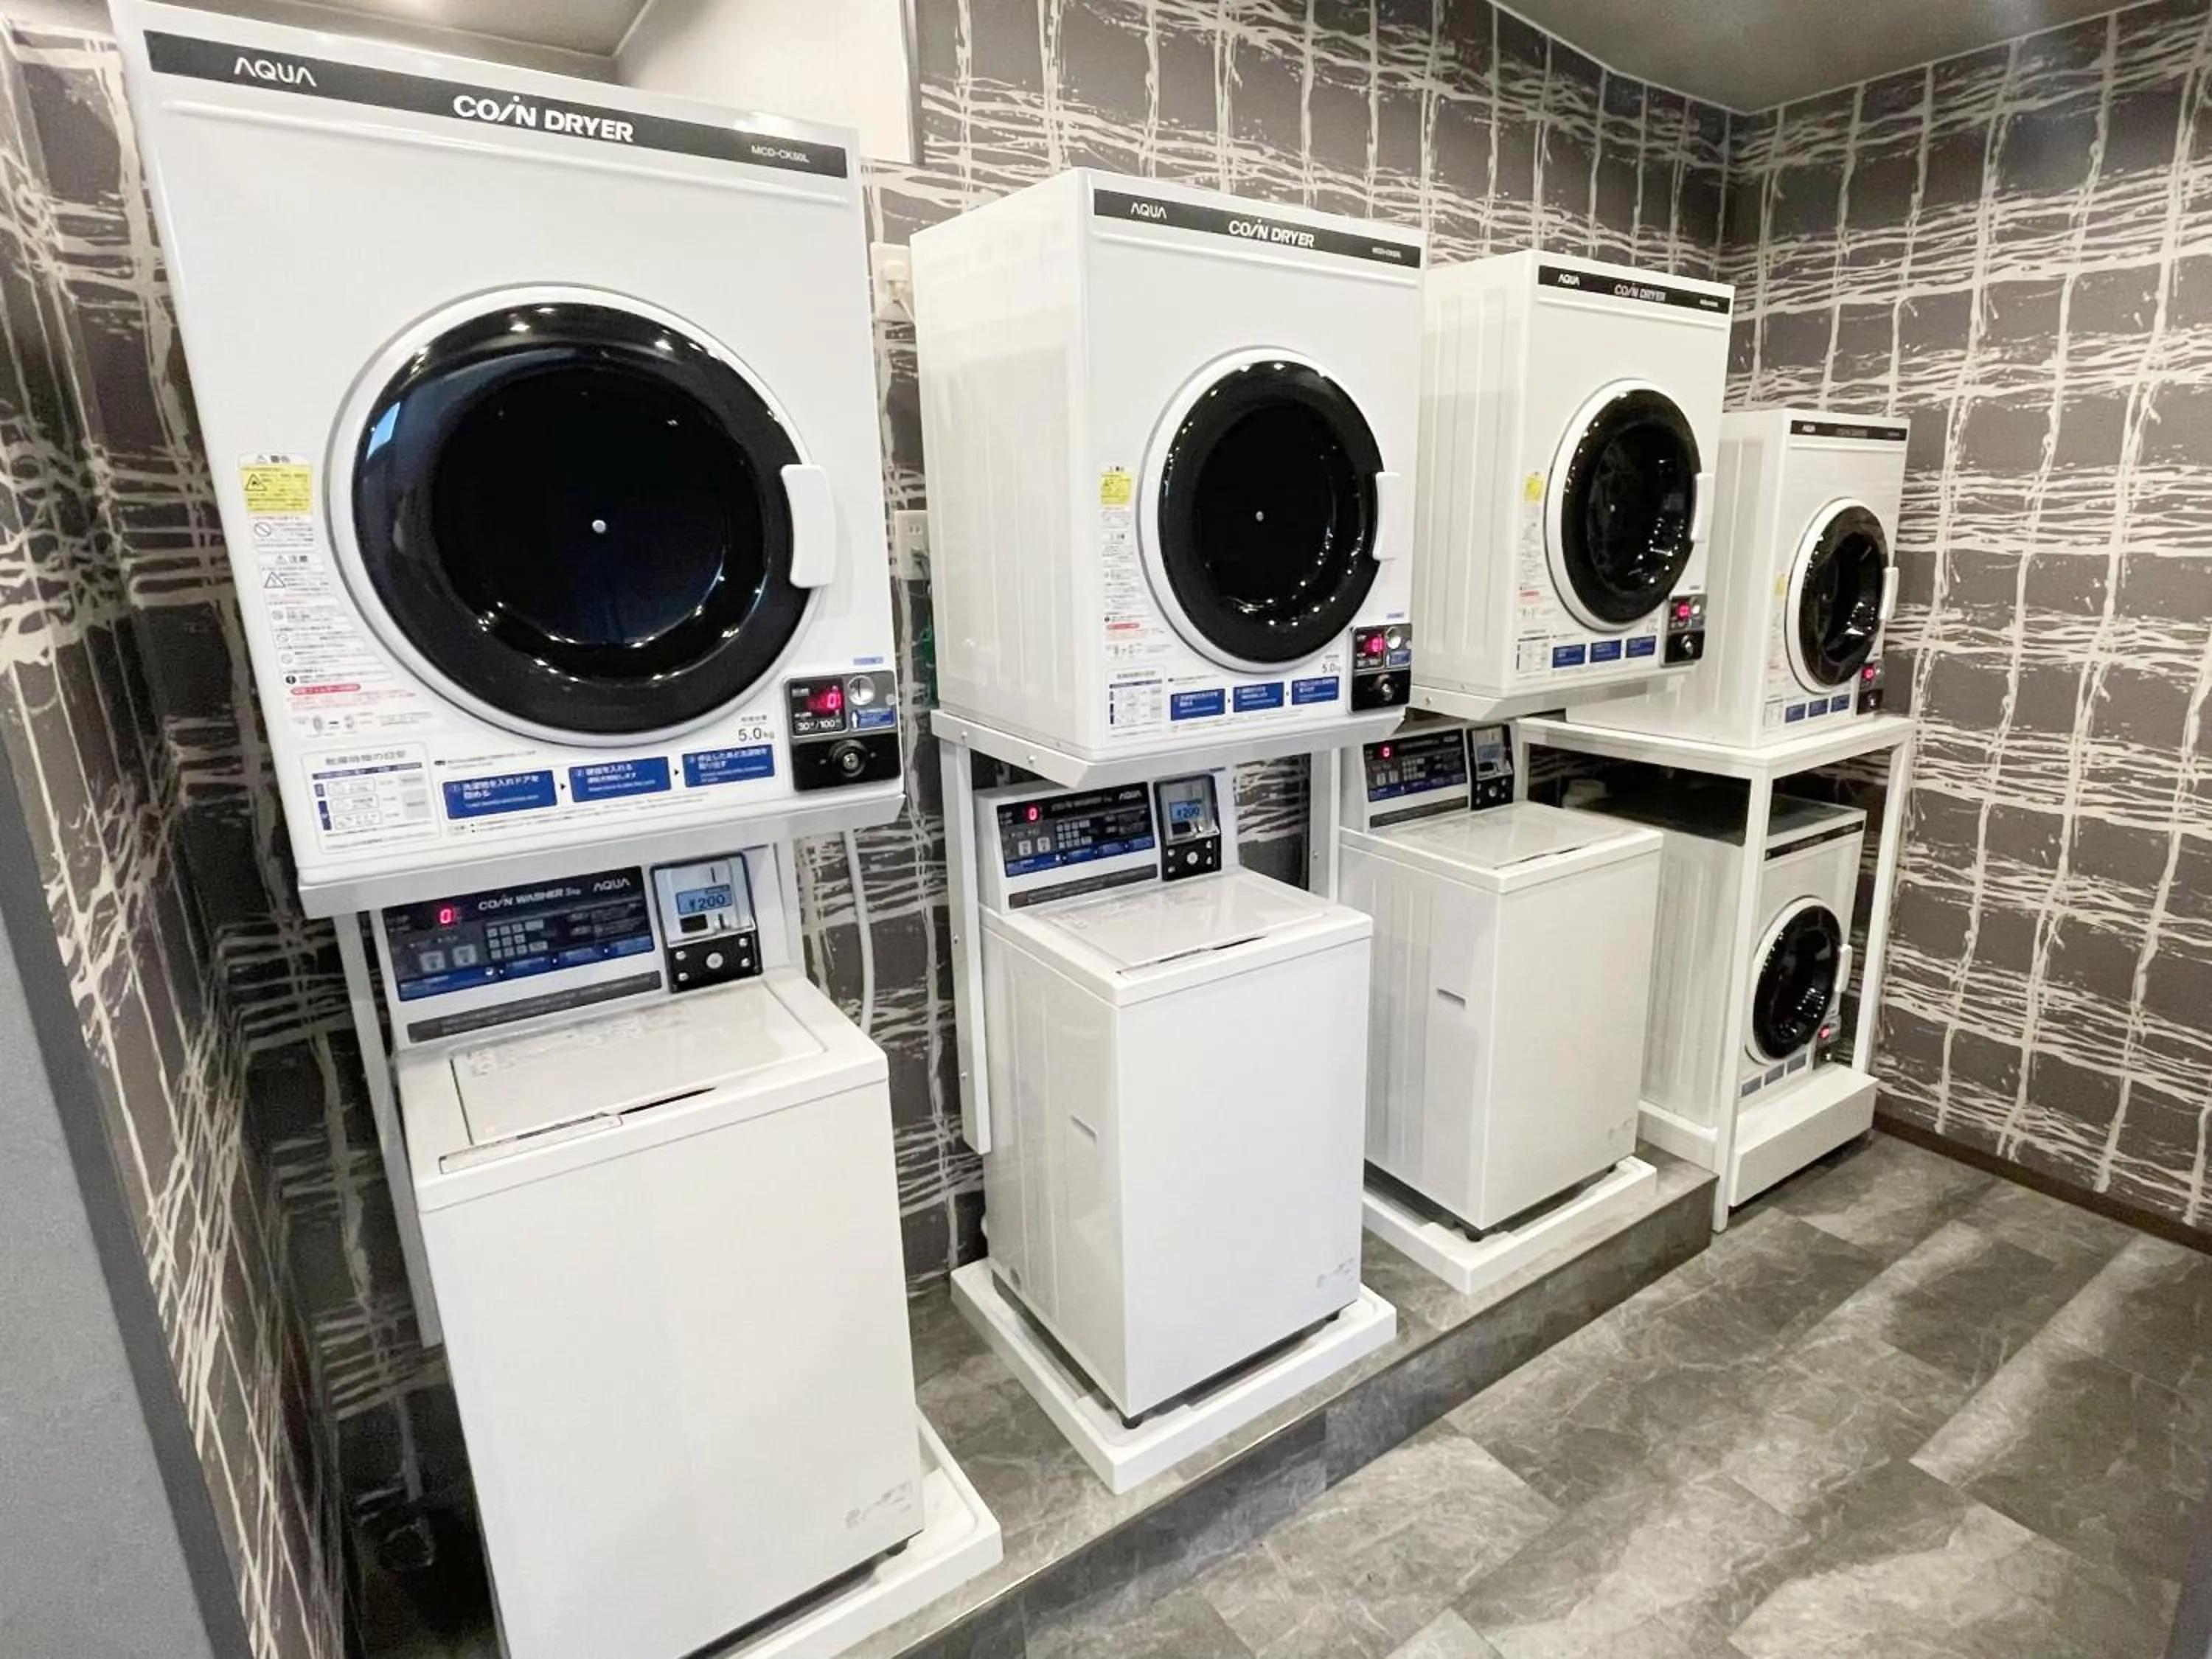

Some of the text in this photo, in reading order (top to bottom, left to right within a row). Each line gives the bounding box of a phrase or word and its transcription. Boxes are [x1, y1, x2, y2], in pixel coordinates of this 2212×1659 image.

[234, 57, 317, 87] AQUA
[544, 109, 633, 142] DRYER
[1130, 202, 1167, 220] AQUA
[1270, 228, 1315, 248] DRYER
[1028, 807, 1037, 821] 0
[593, 877, 631, 892] AQUA
[439, 908, 452, 924] 0
